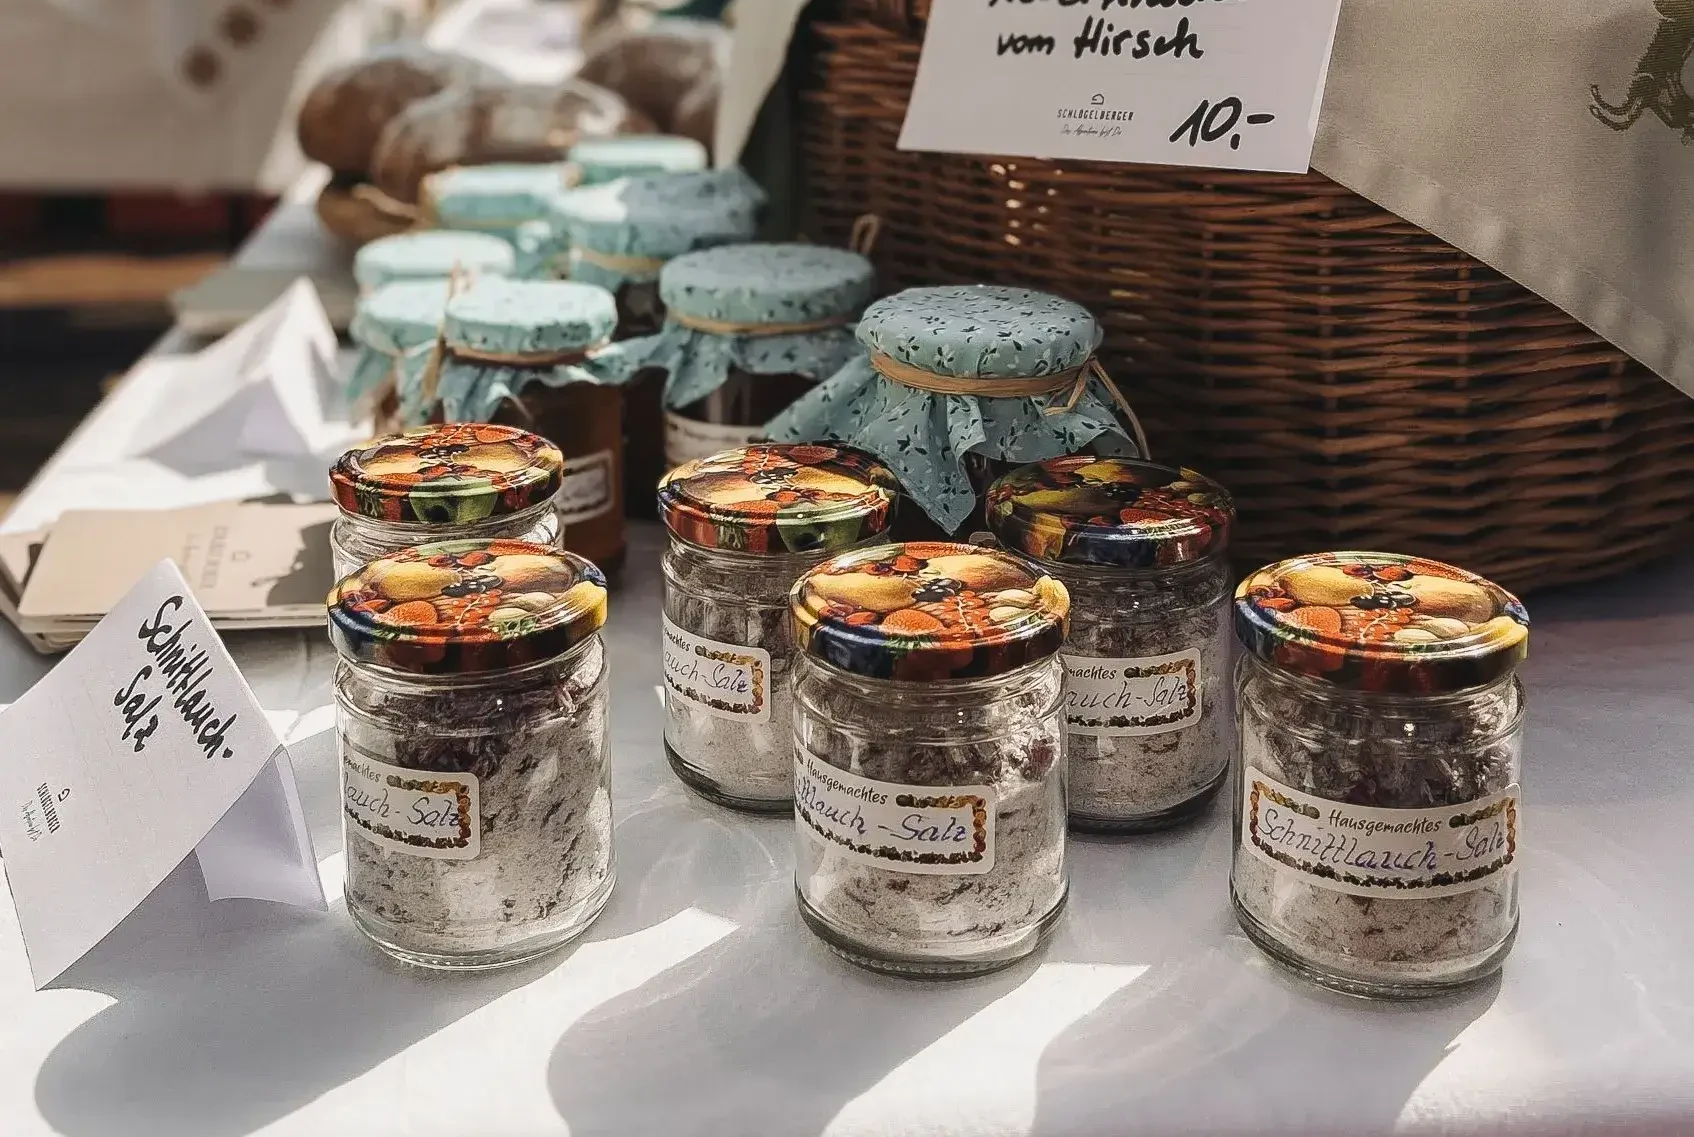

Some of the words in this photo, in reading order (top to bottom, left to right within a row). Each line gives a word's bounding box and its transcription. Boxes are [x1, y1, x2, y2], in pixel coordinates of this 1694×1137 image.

[997, 32, 1056, 57] vom
[1073, 15, 1205, 60] Hirsch
[113, 664, 163, 753] Salz
[807, 759, 888, 806] Hausgemachtes
[1328, 808, 1442, 836] Hausgemachtes
